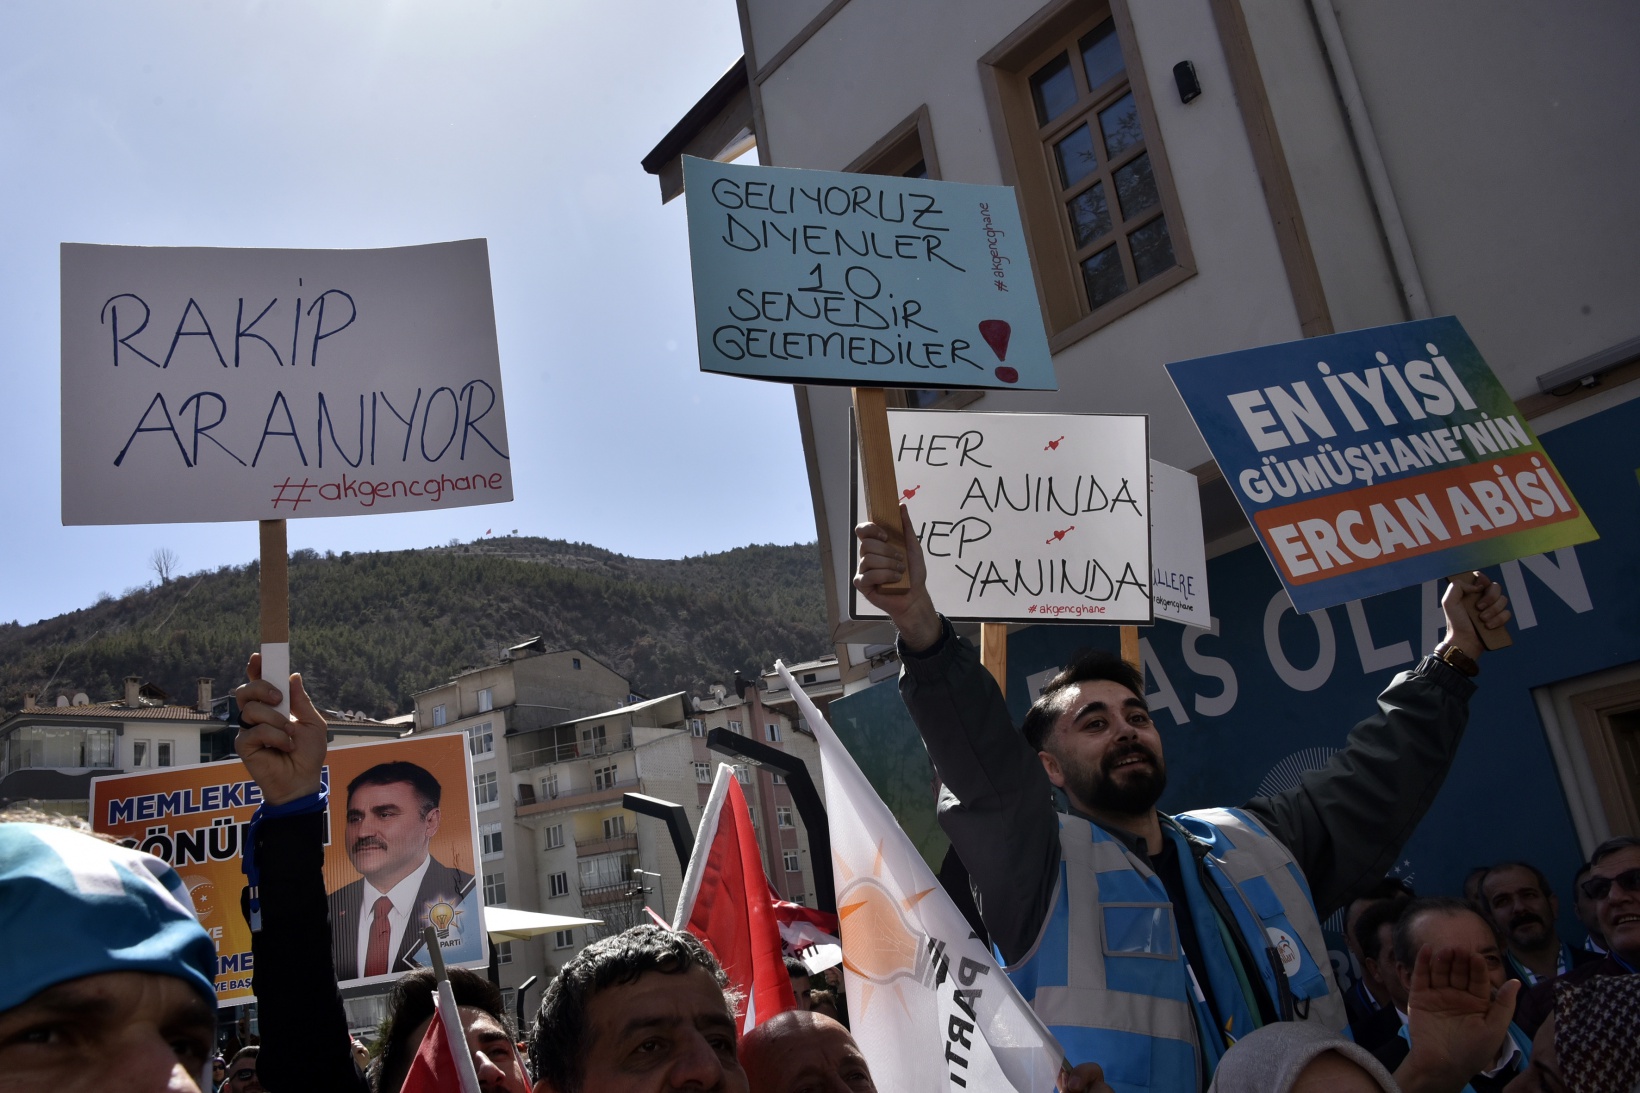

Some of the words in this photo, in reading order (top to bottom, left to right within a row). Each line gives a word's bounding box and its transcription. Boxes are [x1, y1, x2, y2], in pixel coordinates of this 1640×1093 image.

[711, 178, 949, 231] GELIYORUZ
[722, 213, 966, 272] DIYENLER
[979, 202, 1010, 292] #akgencghane
[798, 263, 881, 299] 10
[101, 278, 357, 368] RAKİP
[113, 379, 510, 467] ARANIYOR
[1227, 381, 1337, 453] EN
[1317, 343, 1477, 432] İYİSİ
[898, 430, 992, 467] HER
[271, 473, 502, 511] #akgencghane
[960, 474, 1142, 516] ANINDA
[1268, 494, 1450, 577] ERCAN
[1446, 456, 1572, 535] ABİSİ
[955, 559, 1150, 602] YANINDA
[108, 780, 263, 826] MEMLEKE
